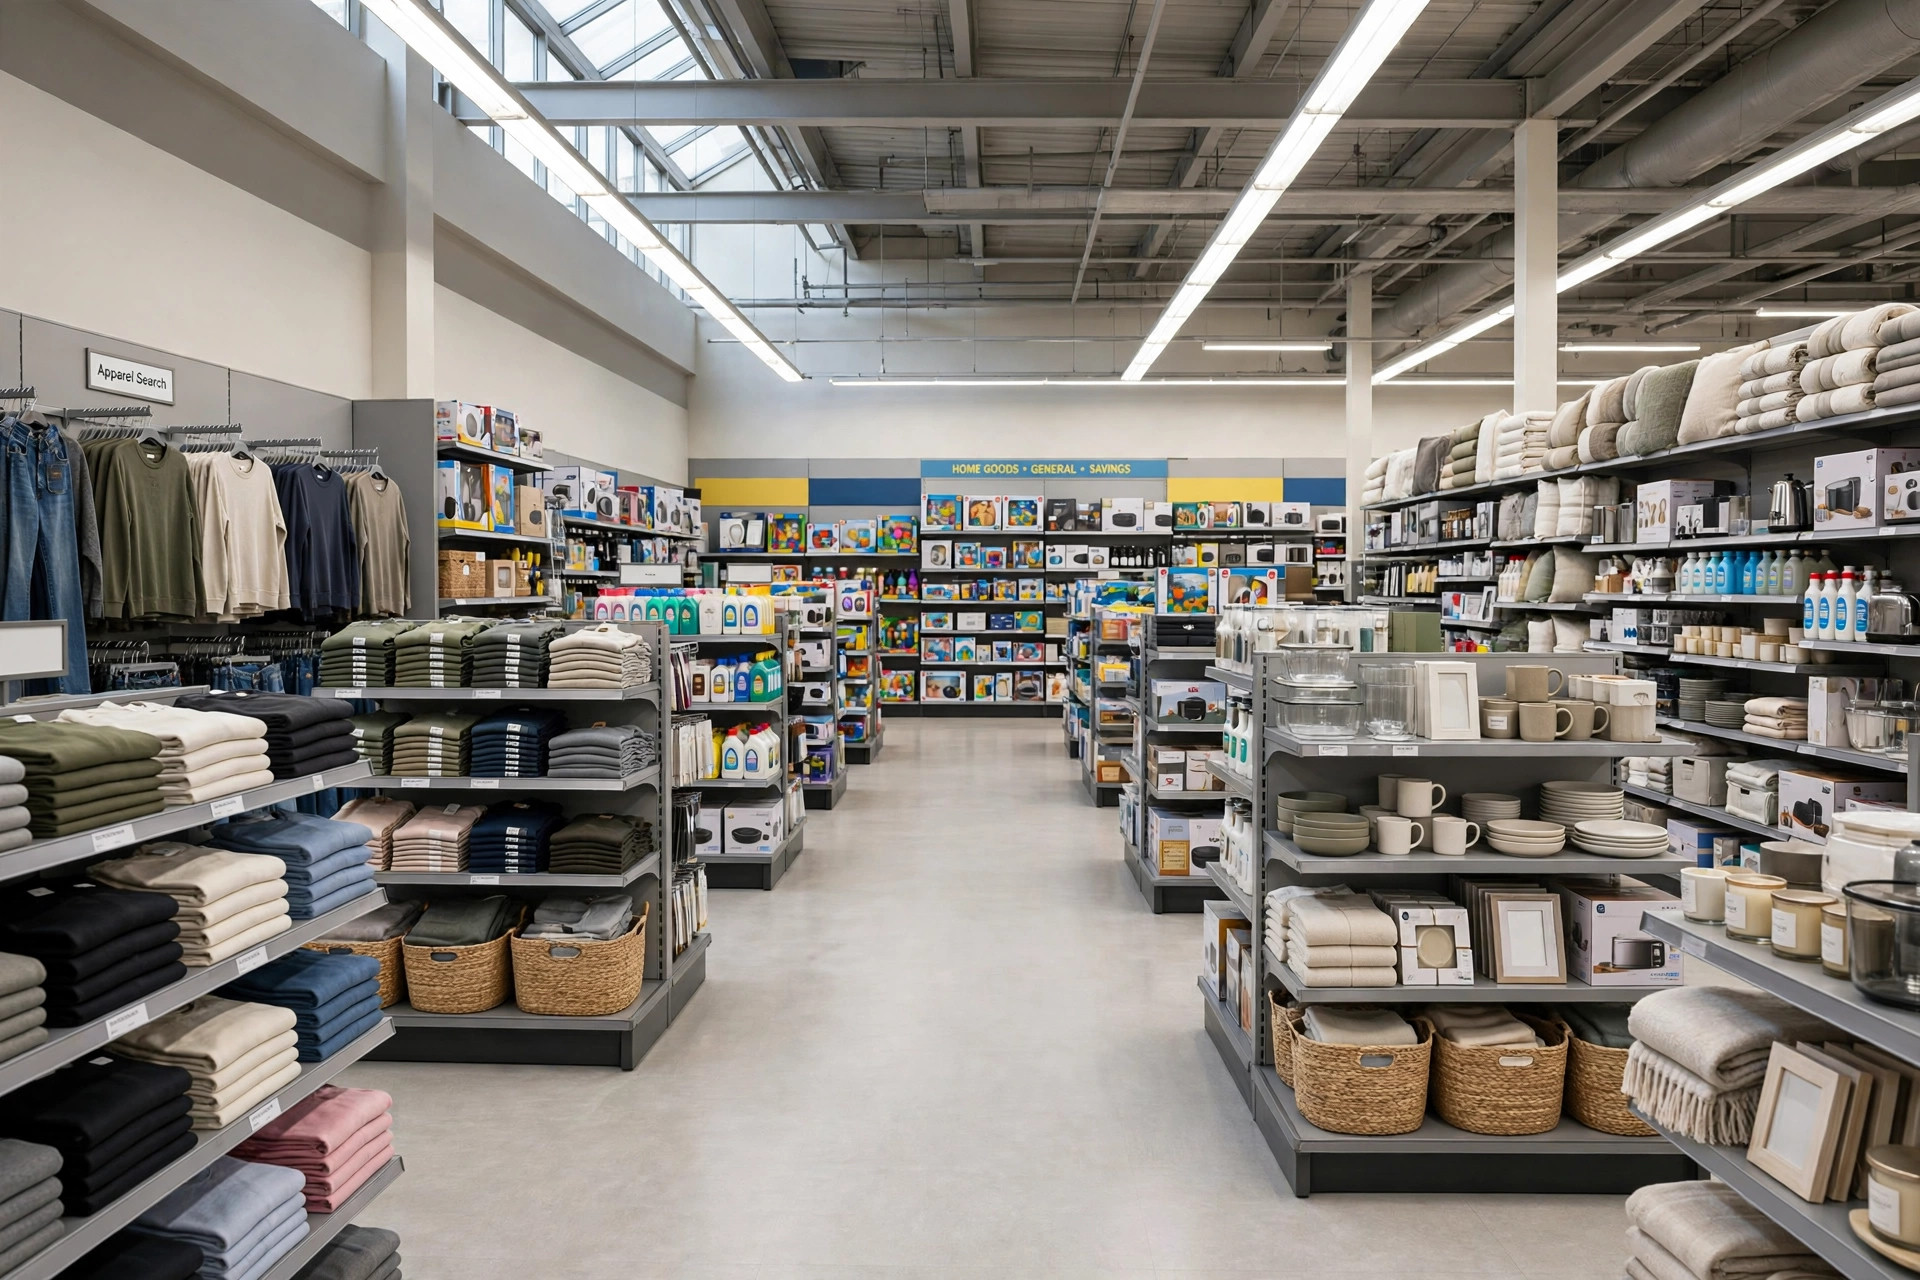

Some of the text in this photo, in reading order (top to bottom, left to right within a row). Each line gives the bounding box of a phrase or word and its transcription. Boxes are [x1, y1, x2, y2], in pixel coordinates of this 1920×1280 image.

[97, 363, 167, 389] Apparel Search
[952, 463, 1131, 474] HOME GOODS GENERAL SAVINGS
